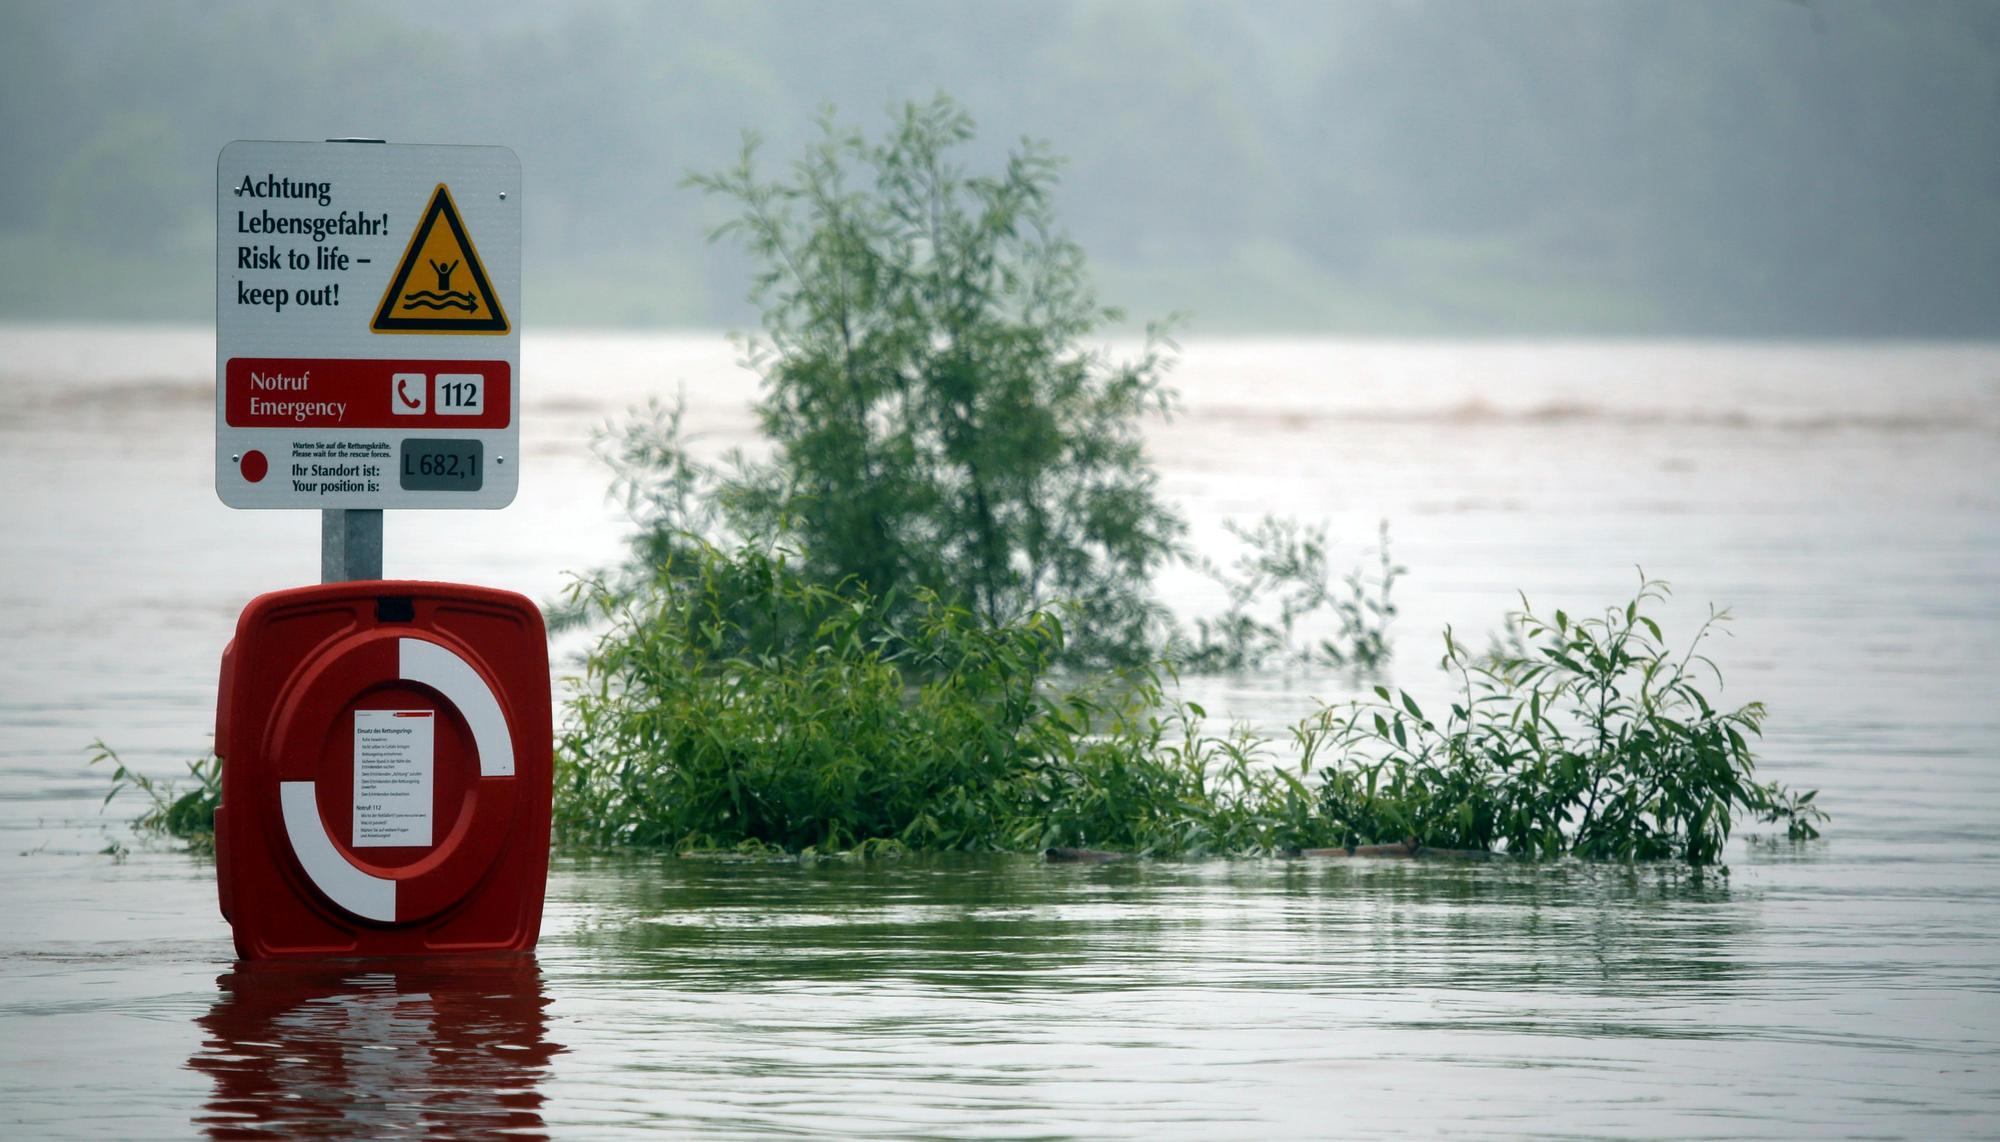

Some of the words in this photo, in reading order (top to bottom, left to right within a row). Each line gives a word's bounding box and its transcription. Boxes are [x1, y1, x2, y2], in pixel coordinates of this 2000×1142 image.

[239, 174, 331, 206] Achtung
[238, 209, 388, 242] Lebensgefahr!
[238, 245, 281, 269] Risk
[288, 249, 310, 270] to
[317, 246, 349, 270] life
[238, 281, 288, 312] keep
[296, 284, 339, 306] out!
[250, 371, 310, 391] Notruf
[441, 382, 477, 407] 112
[250, 397, 347, 422] Emergency
[292, 464, 308, 476] Ihr
[311, 464, 359, 476] Standort
[363, 464, 380, 476] ist:
[405, 454, 415, 475] L
[420, 454, 476, 479] 682,1
[292, 480, 317, 492] Your
[320, 480, 364, 495] position
[367, 480, 380, 492] is:
